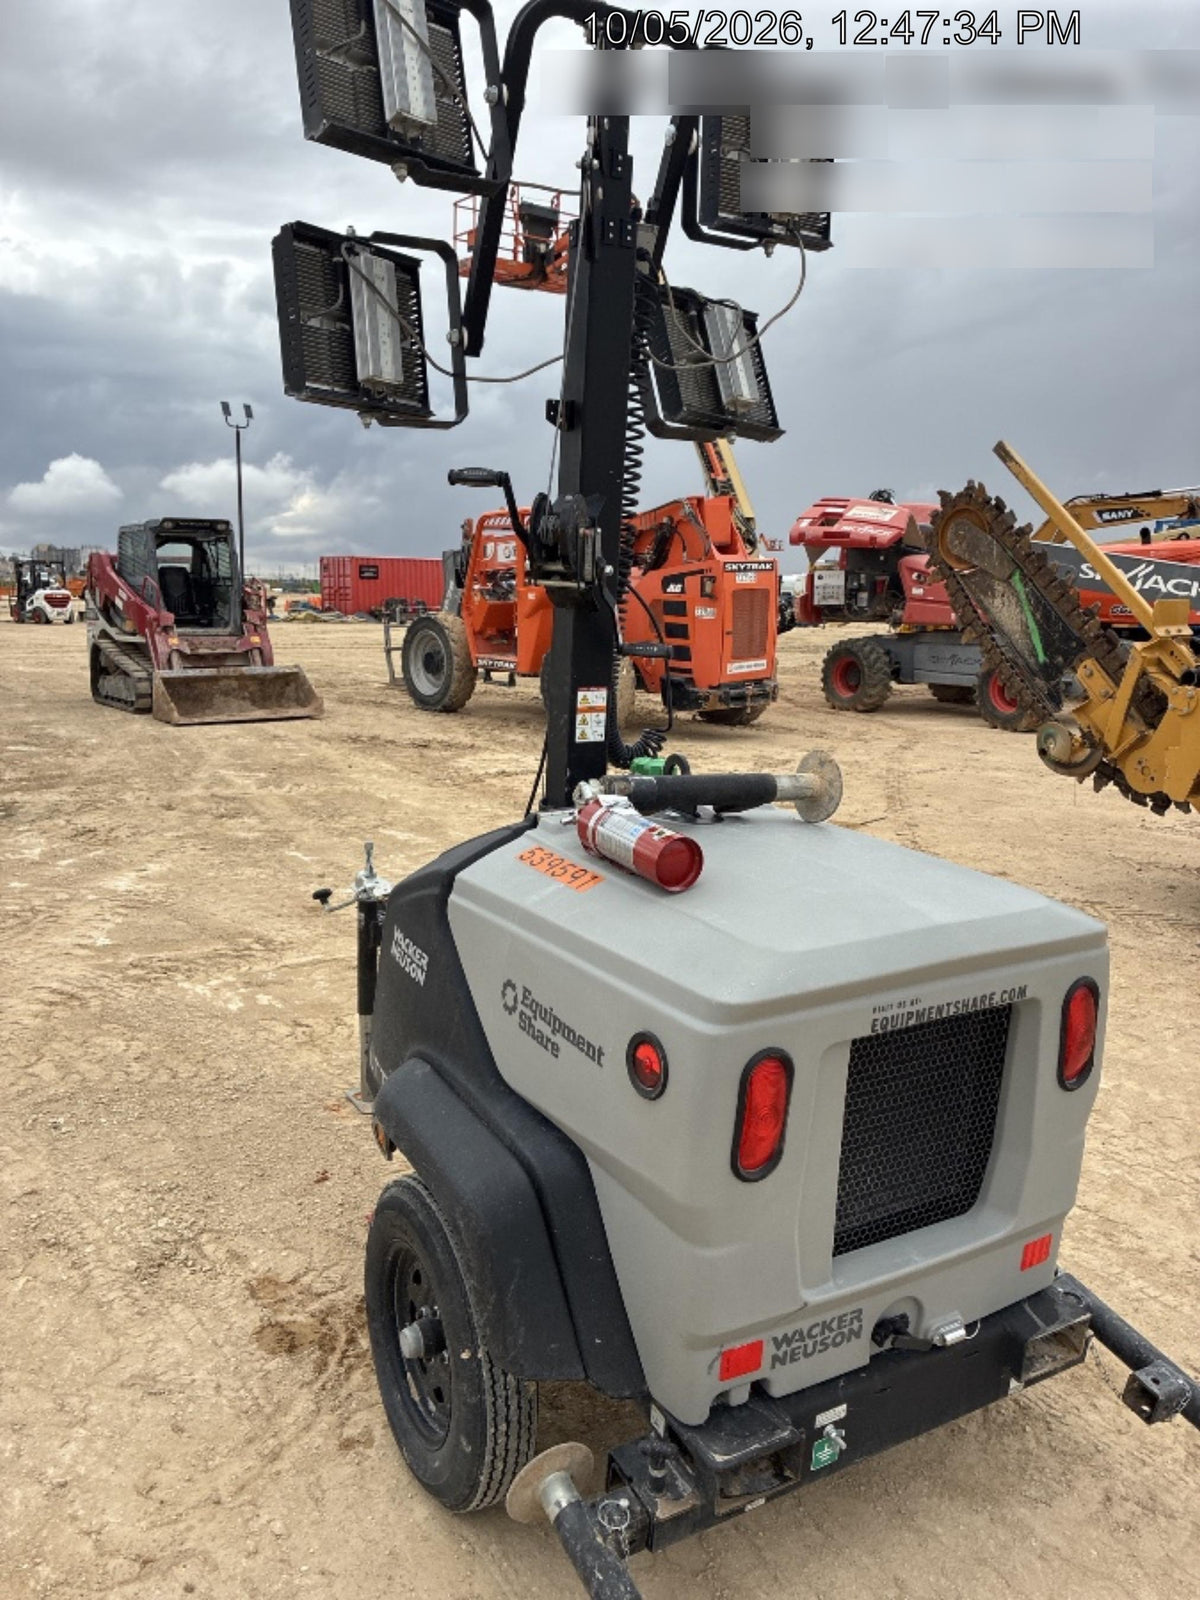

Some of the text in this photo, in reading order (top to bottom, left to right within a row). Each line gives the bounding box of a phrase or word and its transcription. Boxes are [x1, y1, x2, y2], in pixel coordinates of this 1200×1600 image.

[1102, 510, 1133, 520] SANY
[725, 562, 773, 571] SKYTRAK
[477, 658, 517, 669] SKYTRAK
[390, 940, 426, 987] NEUSON
[393, 924, 429, 971] WACKER
[521, 985, 605, 1068] Equipment
[871, 985, 1028, 1033] EQUIPMENTSHARE.COM
[518, 1009, 560, 1059] Share
[770, 1324, 863, 1369] NEUSON
[771, 1308, 863, 1351] WACKER
